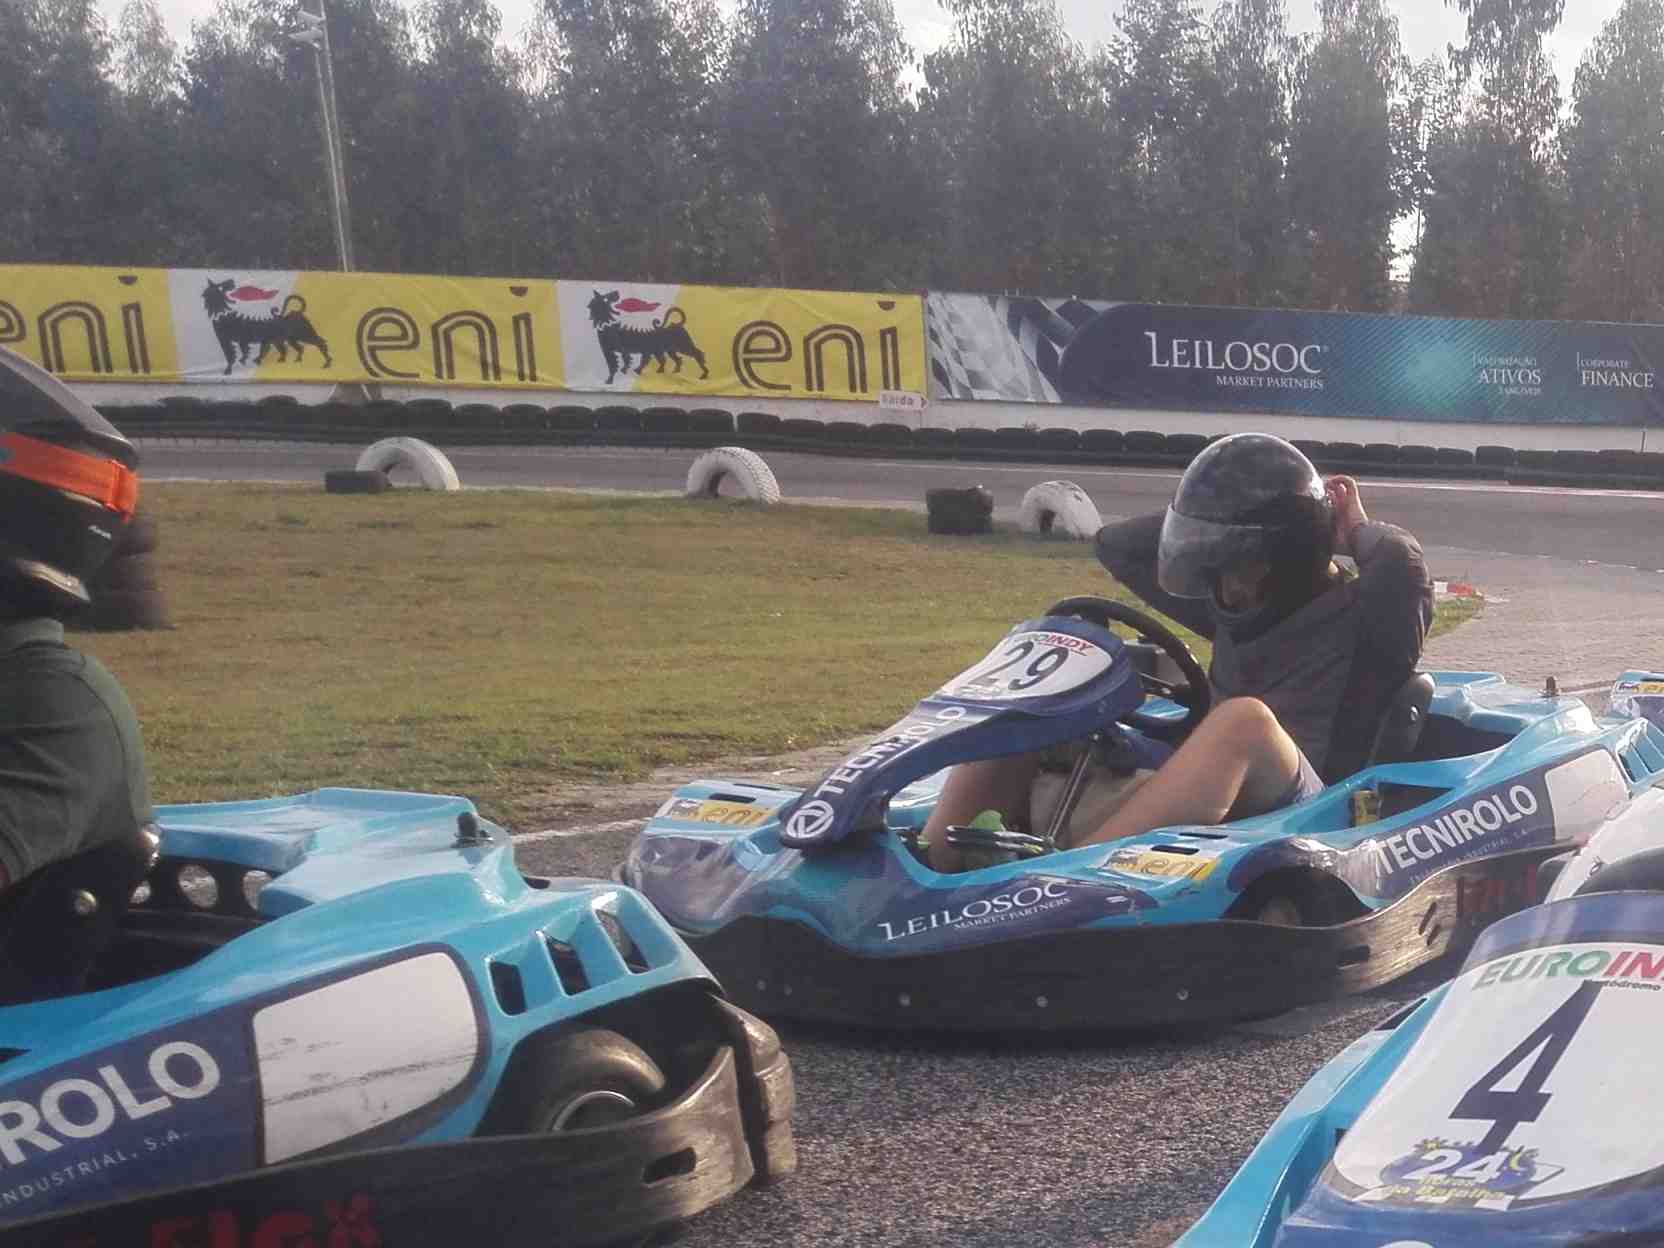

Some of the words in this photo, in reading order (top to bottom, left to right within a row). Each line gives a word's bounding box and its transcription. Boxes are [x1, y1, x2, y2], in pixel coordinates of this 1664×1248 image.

[356, 286, 539, 383] eni
[732, 300, 900, 393] eni
[1144, 331, 1321, 374] LEILOSOC
[1216, 375, 1264, 387] MARKET
[1266, 377, 1324, 390] PARTNERS
[1478, 369, 1542, 385] ATIVOS
[1582, 371, 1656, 389] FINANCE
[967, 640, 1070, 690] 29
[1375, 785, 1538, 874] TECNIROLO
[877, 881, 1068, 941] LEILOSOC
[1448, 980, 1602, 1155] 4
[0, 1041, 220, 1166] ROLO
[0, 1149, 138, 1206] NDUSTRIAL,
